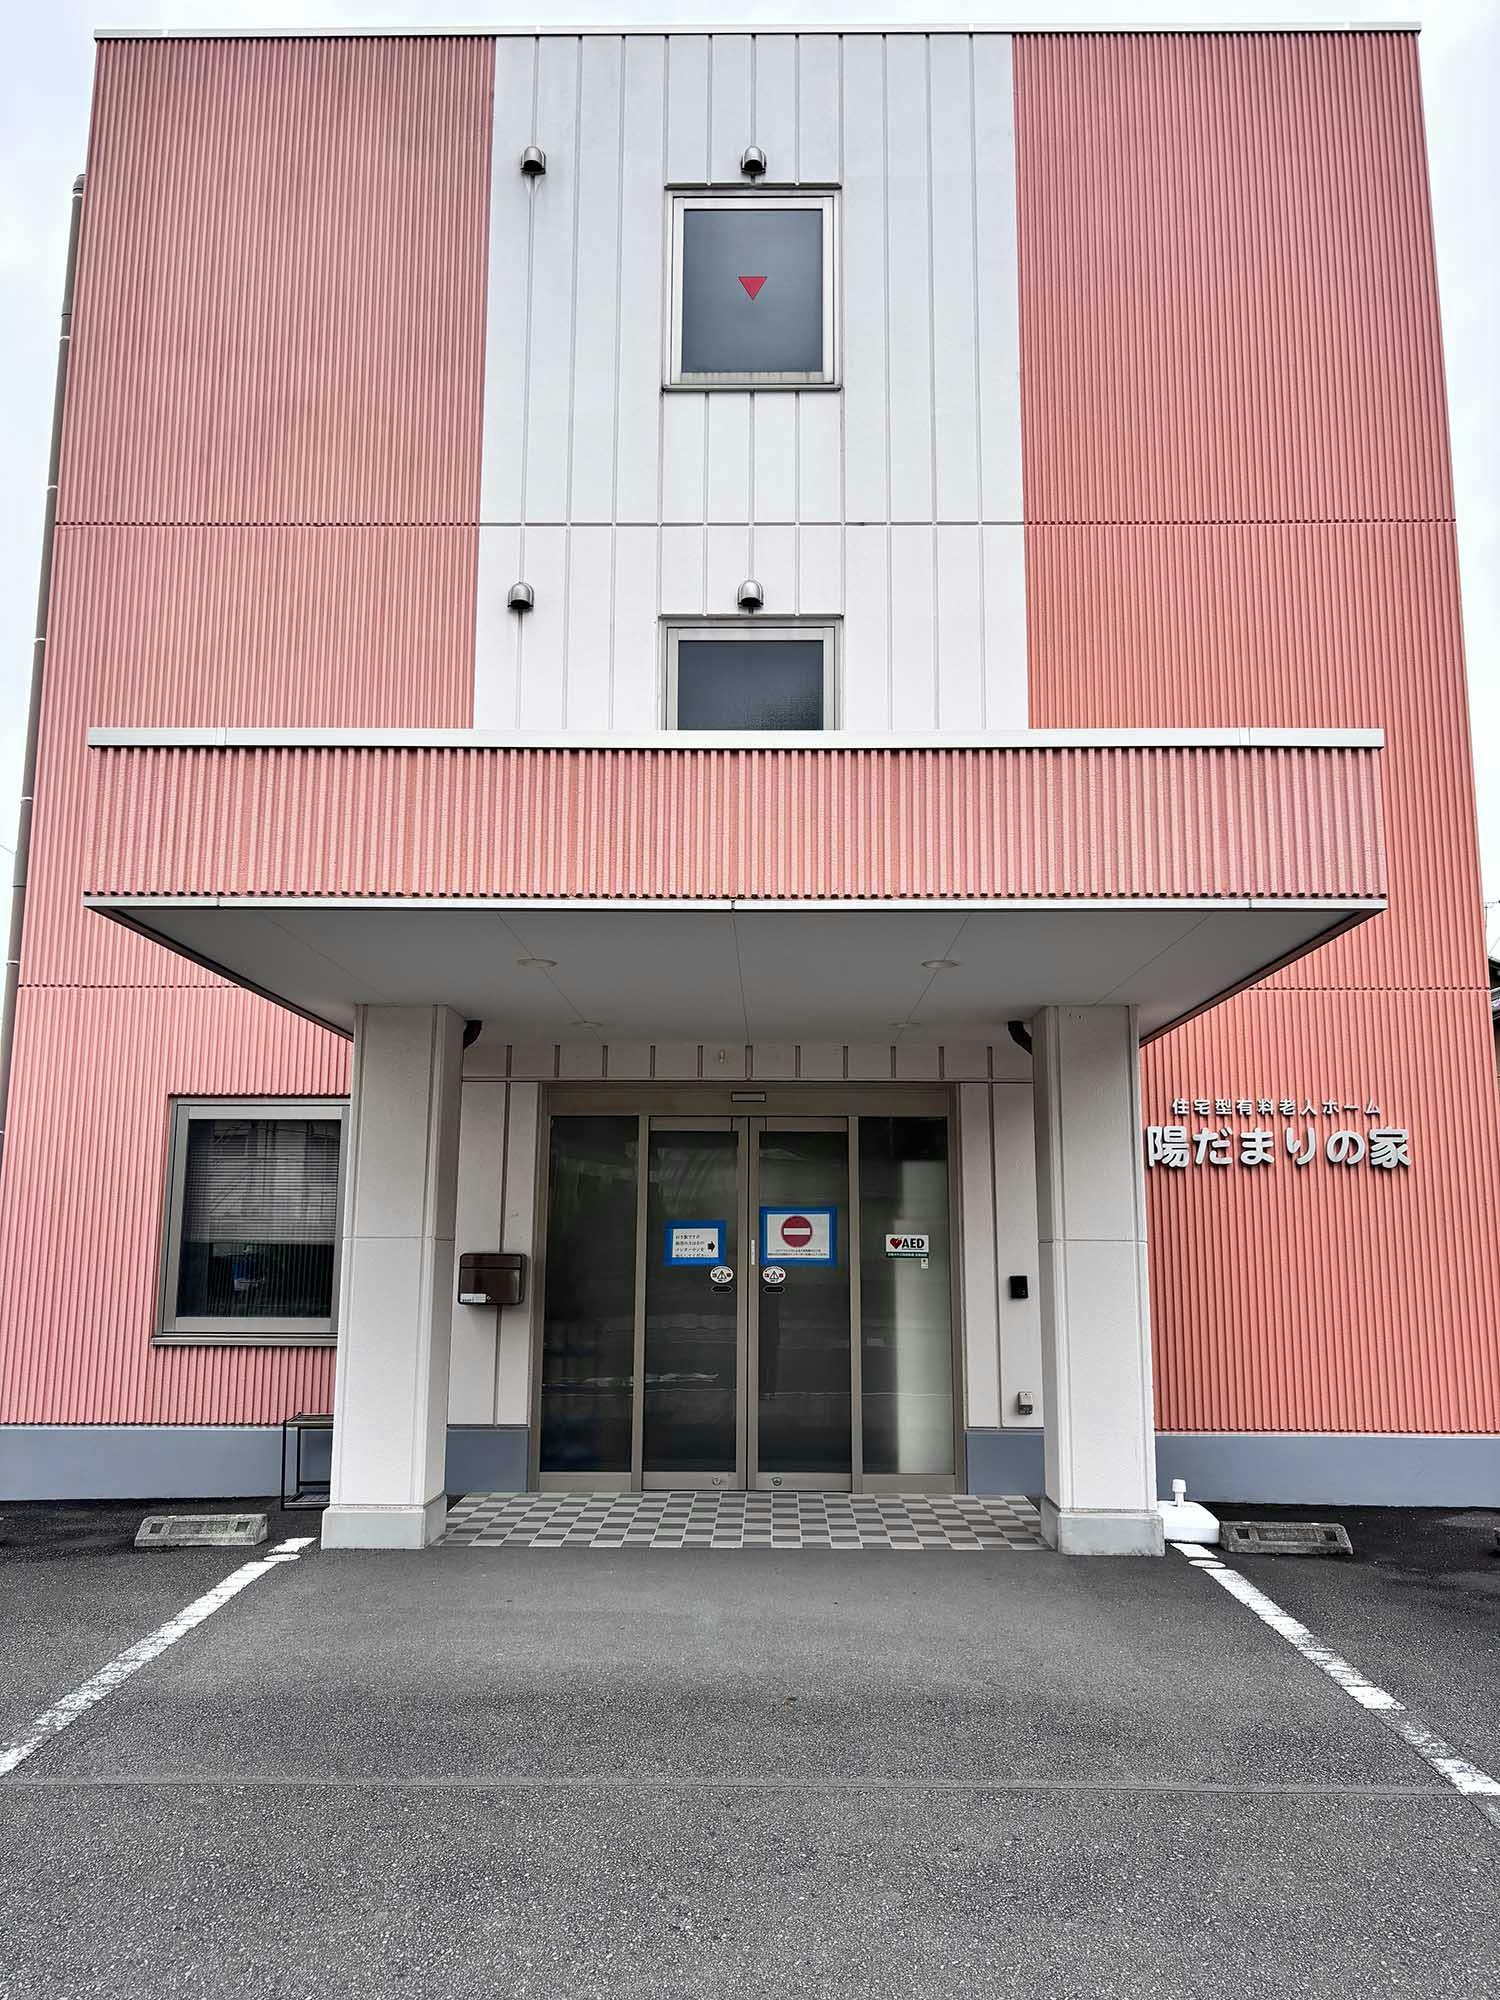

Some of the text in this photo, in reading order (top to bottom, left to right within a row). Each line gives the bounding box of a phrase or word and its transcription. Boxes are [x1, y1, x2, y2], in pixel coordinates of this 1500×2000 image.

[1172, 1098, 1381, 1115] 住宅型有料老人ホーム
[1147, 1126, 1411, 1168] 陽だまりの家
[902, 1238, 925, 1249] AED
